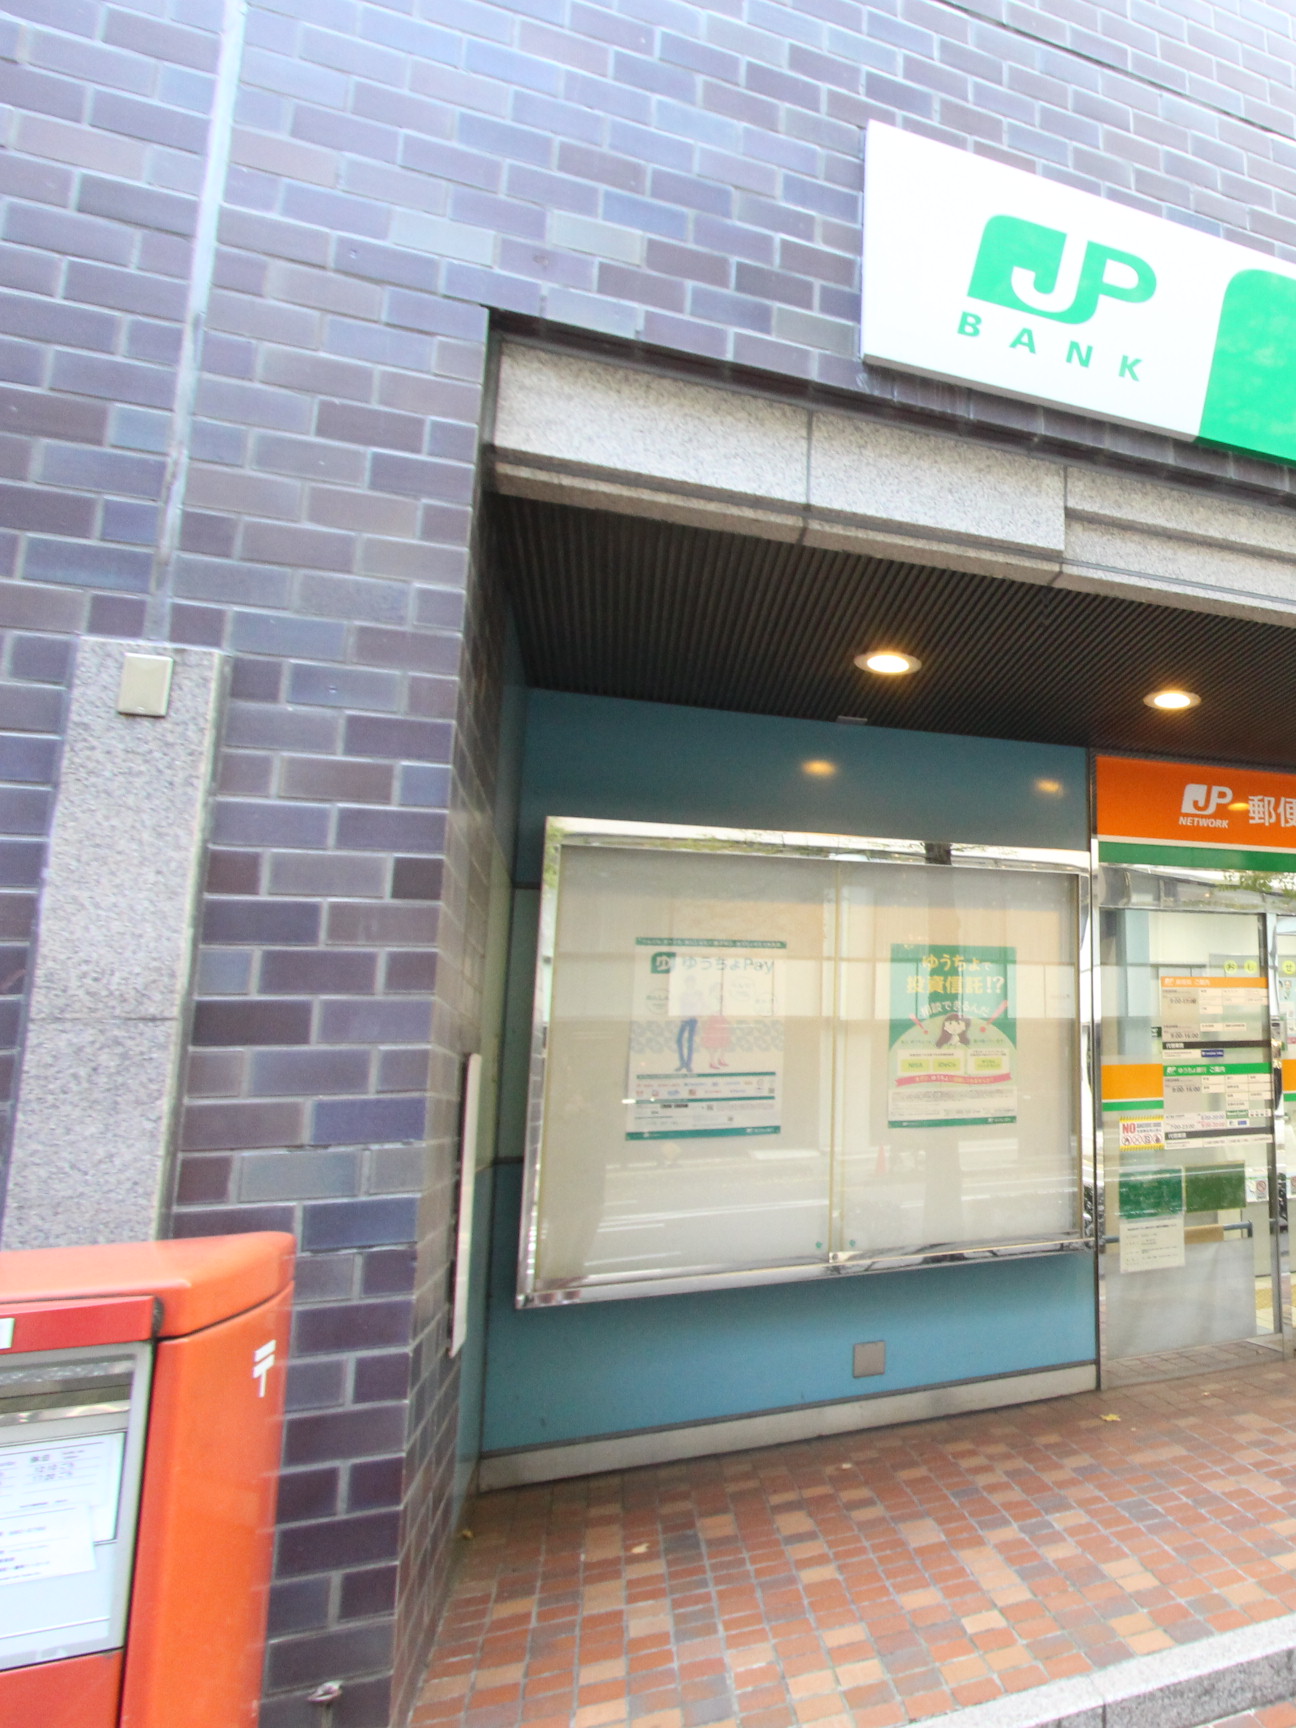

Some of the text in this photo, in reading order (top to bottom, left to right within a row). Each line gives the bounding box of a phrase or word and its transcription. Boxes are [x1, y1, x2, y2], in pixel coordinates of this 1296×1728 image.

[966, 213, 1158, 325] JP
[956, 310, 1144, 383] BANK
[1180, 783, 1234, 816] JP
[1178, 816, 1230, 829] NETWORK
[681, 956, 776, 975] ゆうちょPay
[921, 953, 993, 972] ゆうちょで
